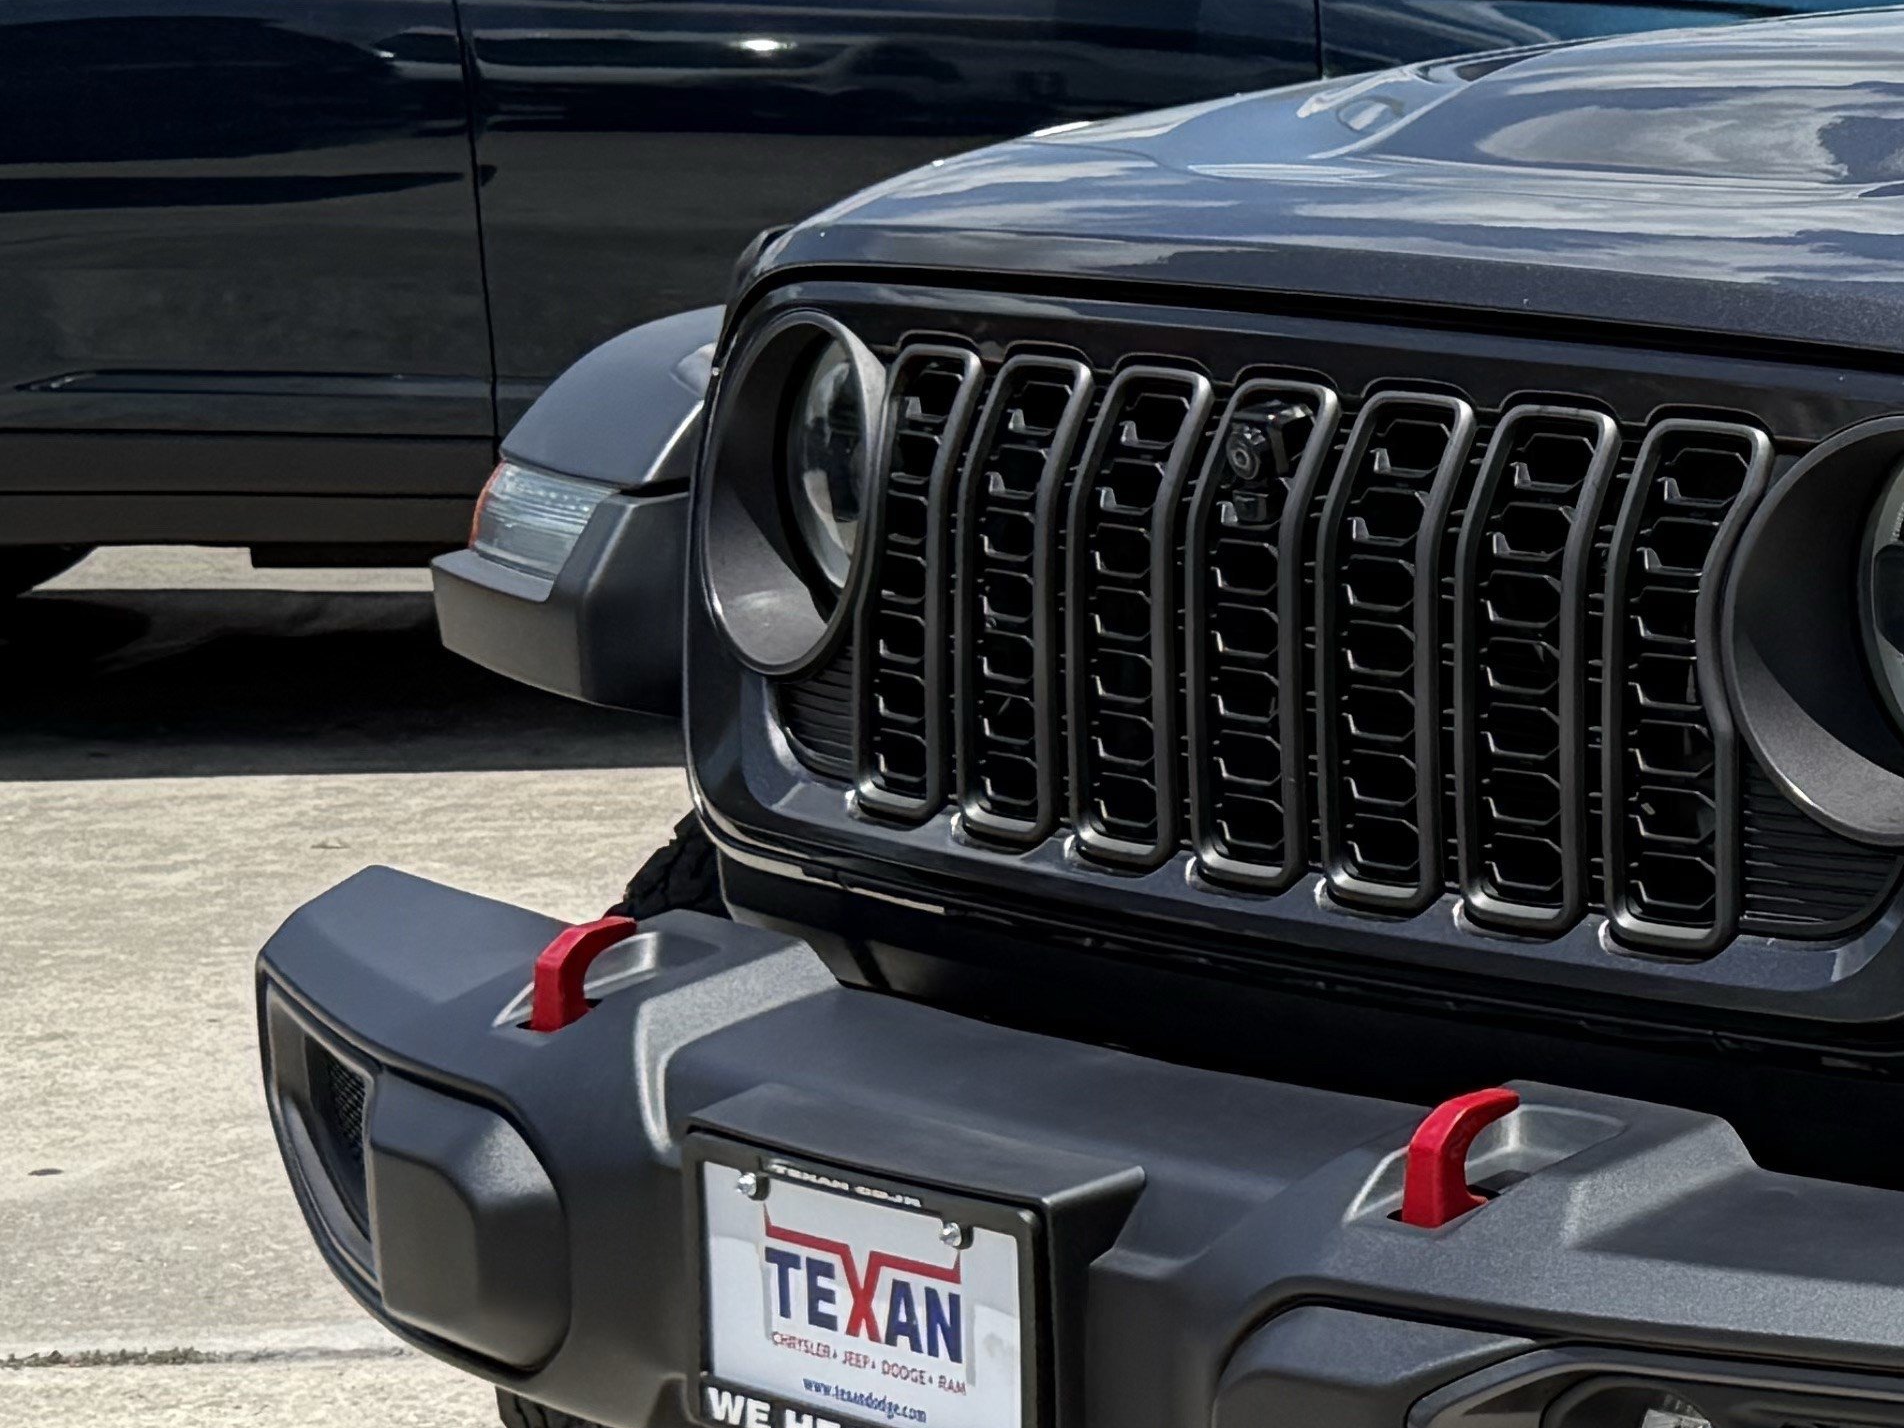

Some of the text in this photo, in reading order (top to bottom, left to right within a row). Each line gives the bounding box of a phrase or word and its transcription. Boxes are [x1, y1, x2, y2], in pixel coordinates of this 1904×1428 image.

[764, 1227, 963, 1364] TEXAN
[771, 1330, 967, 1396] CHRYSLER JEEP DODGE RAM
[802, 1377, 928, 1424] www.texandodge.com
